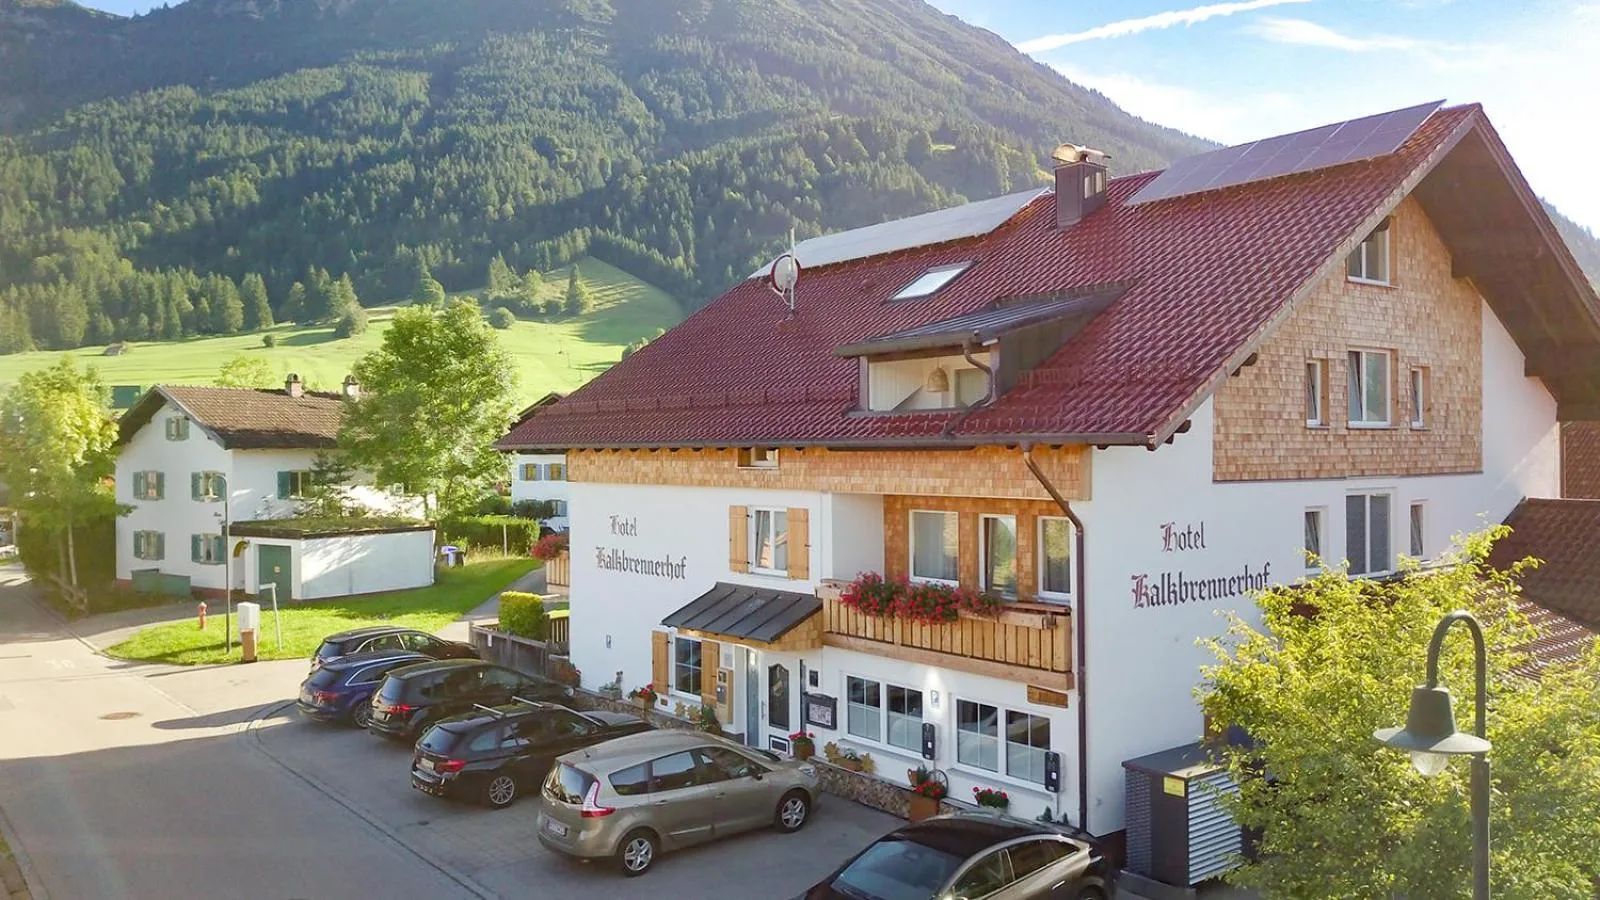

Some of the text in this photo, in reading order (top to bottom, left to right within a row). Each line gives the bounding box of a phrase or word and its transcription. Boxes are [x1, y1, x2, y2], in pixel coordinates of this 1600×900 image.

[609, 514, 637, 537] Hotel
[1160, 521, 1206, 553] Hotel
[595, 546, 687, 580] Kalkbrennerhof
[1131, 562, 1271, 609] Kalkbrennerhof
